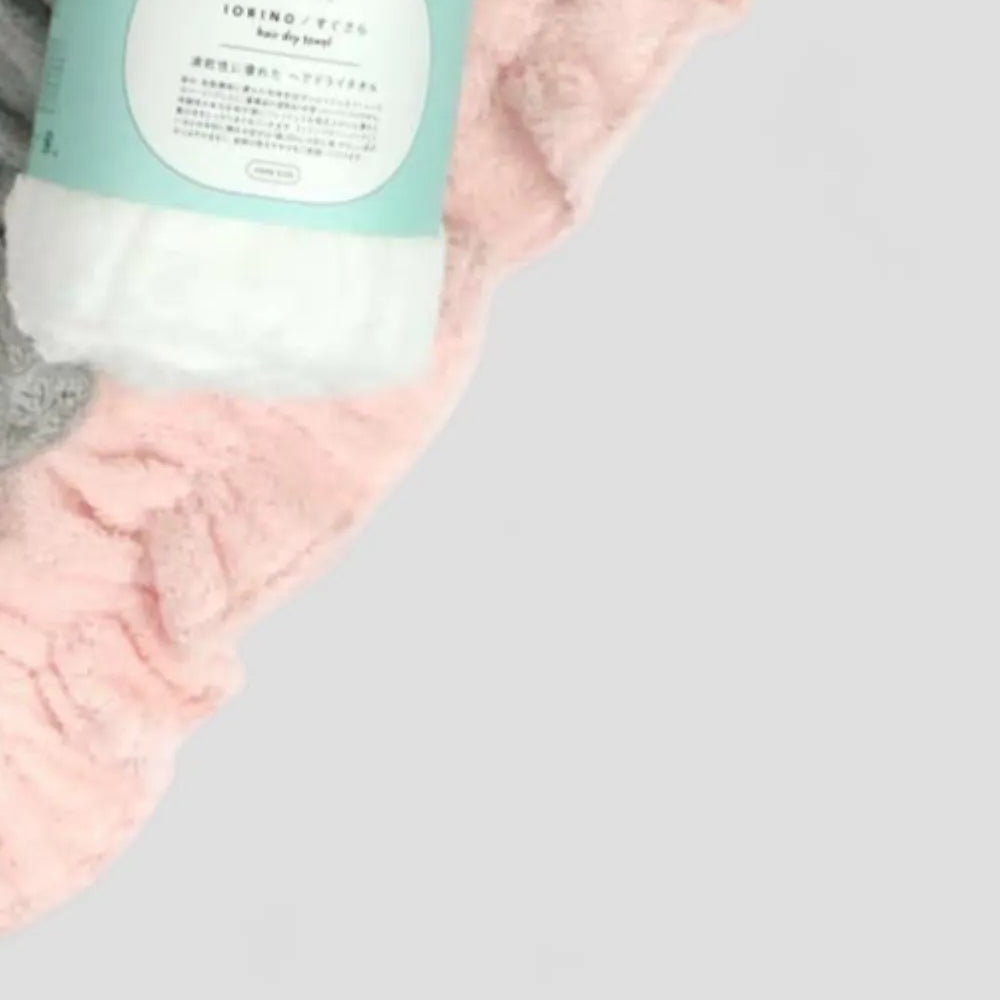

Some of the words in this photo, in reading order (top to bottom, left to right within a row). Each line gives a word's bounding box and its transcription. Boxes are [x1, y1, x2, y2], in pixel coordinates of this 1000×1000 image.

[223, 4, 295, 24] IORINO
[256, 26, 278, 40] hair
[281, 29, 300, 46] dry
[303, 34, 333, 47] towel
